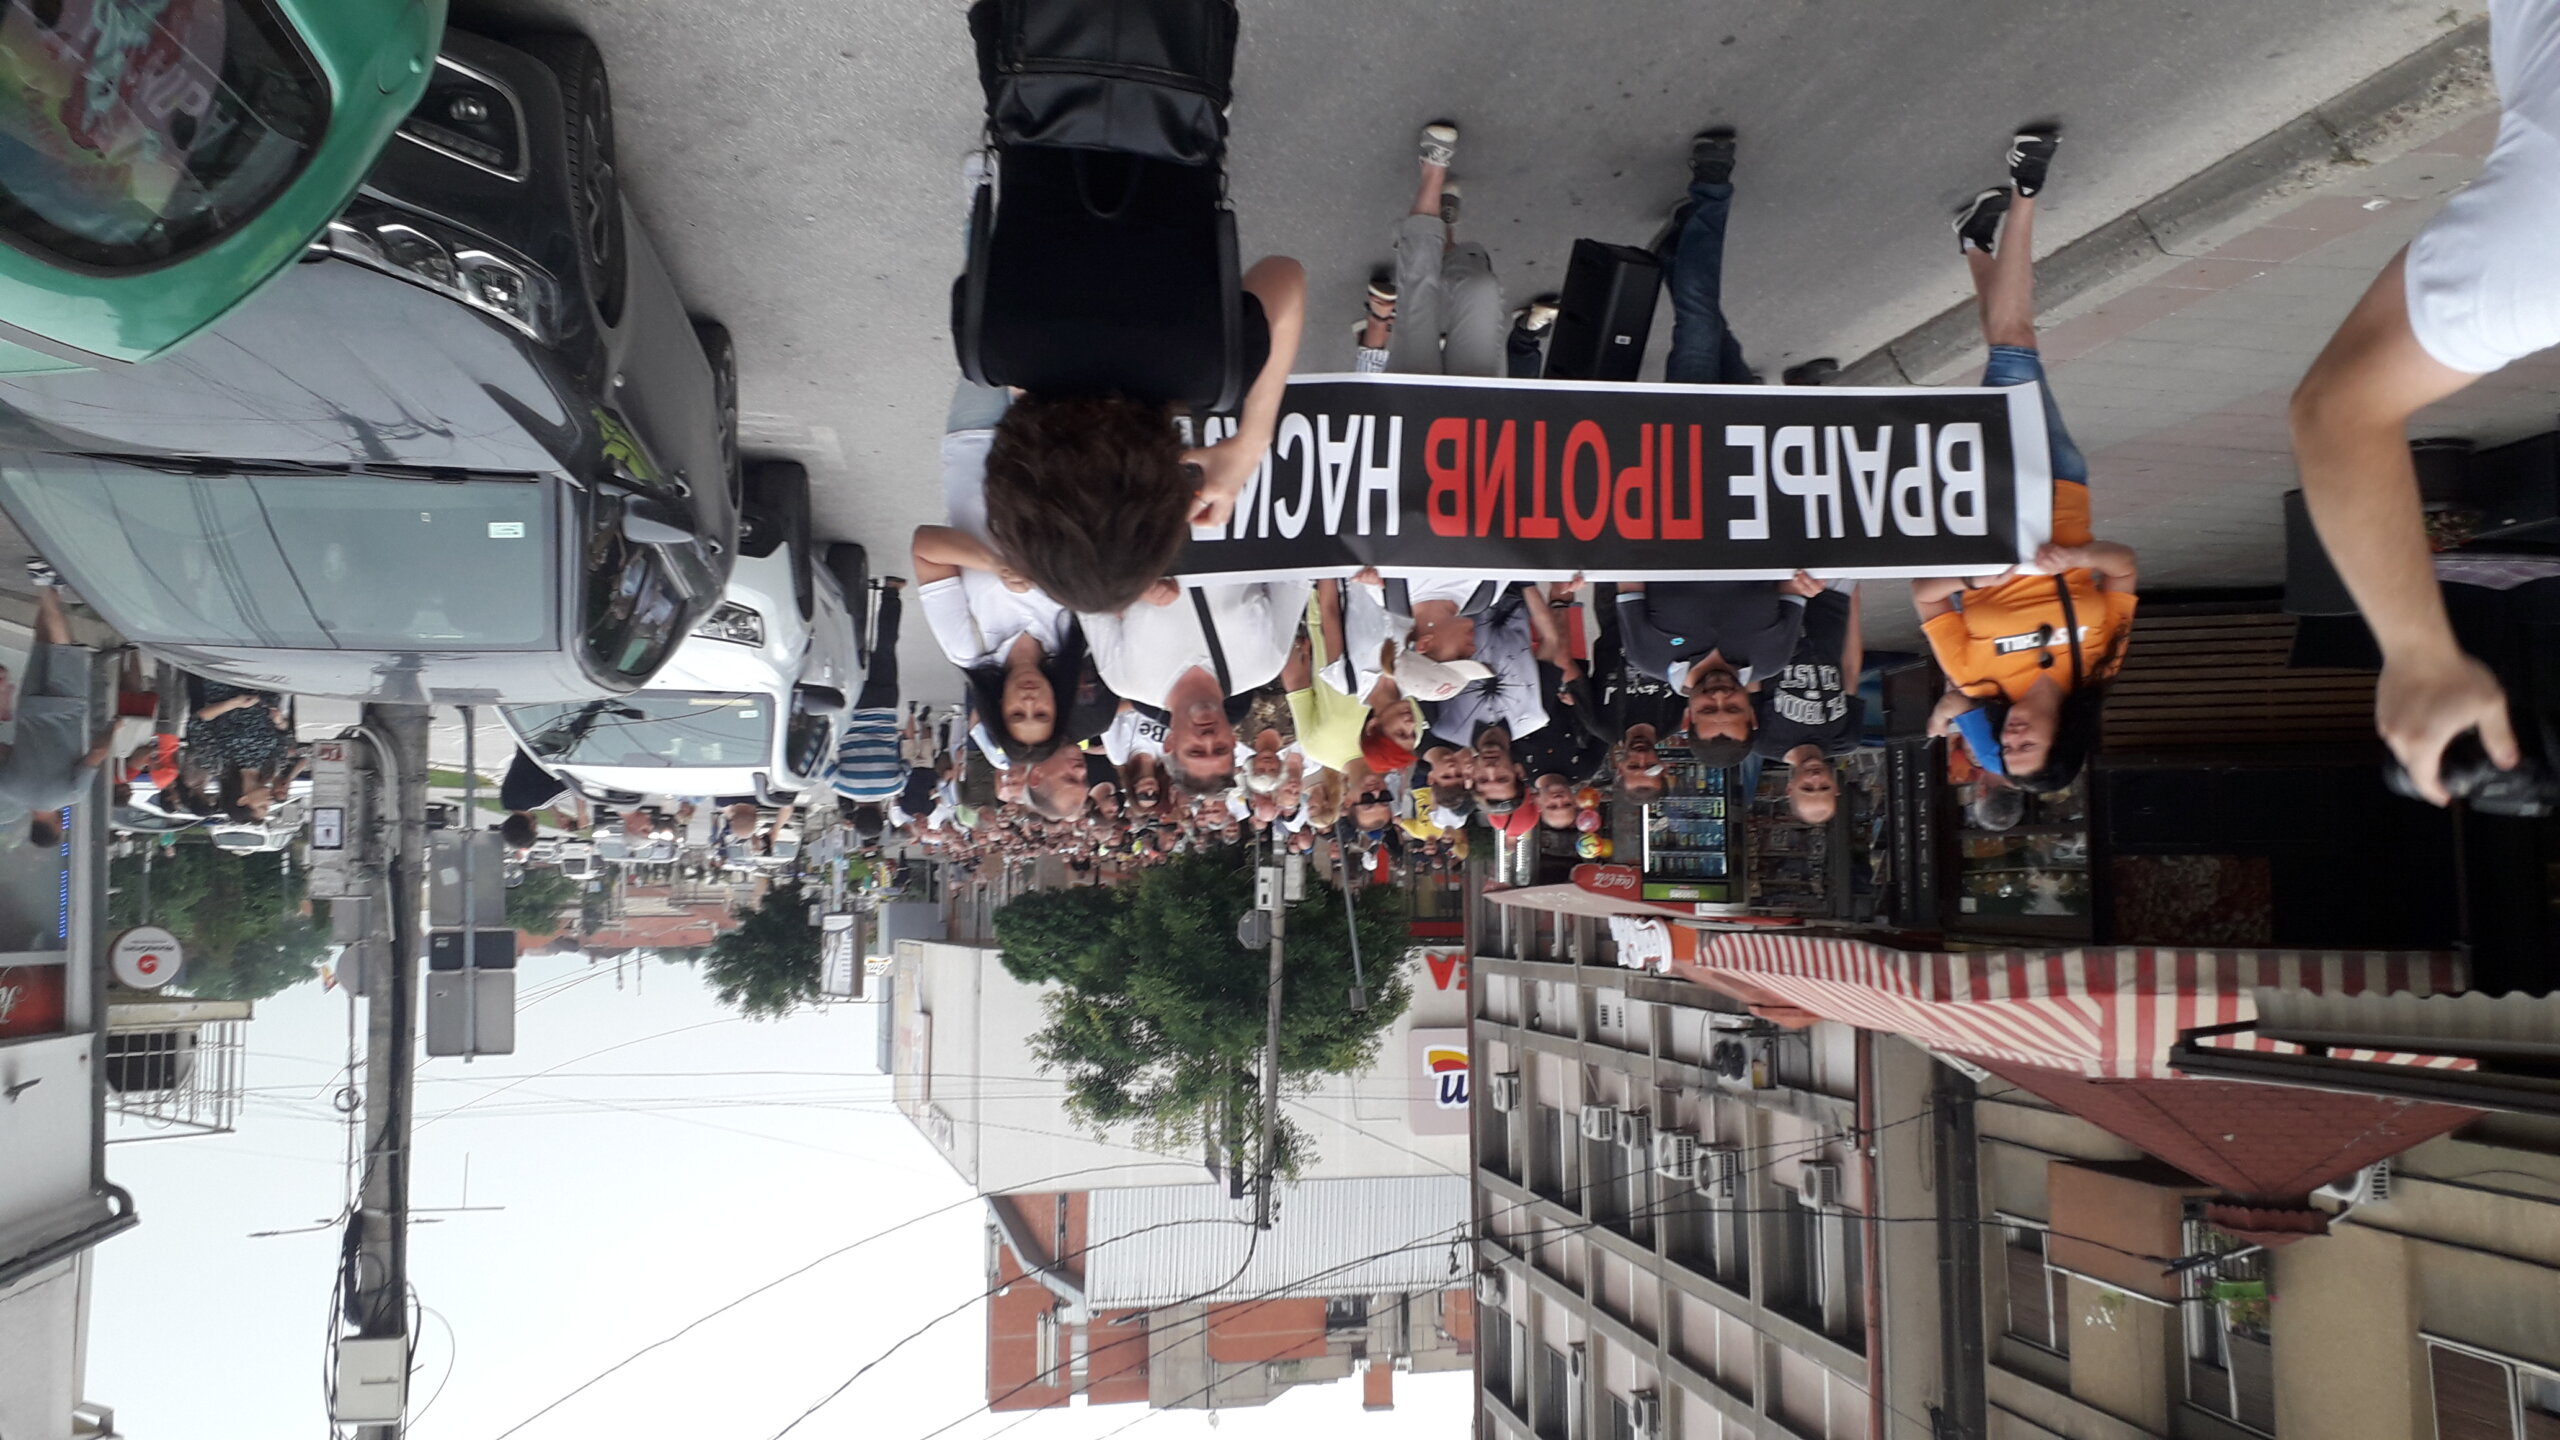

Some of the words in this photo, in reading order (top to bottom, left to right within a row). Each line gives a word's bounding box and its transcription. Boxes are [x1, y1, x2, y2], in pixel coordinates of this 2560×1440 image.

[1171, 412, 1403, 544] НАСИ
[1424, 416, 1703, 541] ПРОТИВ
[1725, 422, 1987, 539] ВРАЊЕ
[2045, 625, 2089, 647] JST
[1139, 723, 1166, 743] Be
